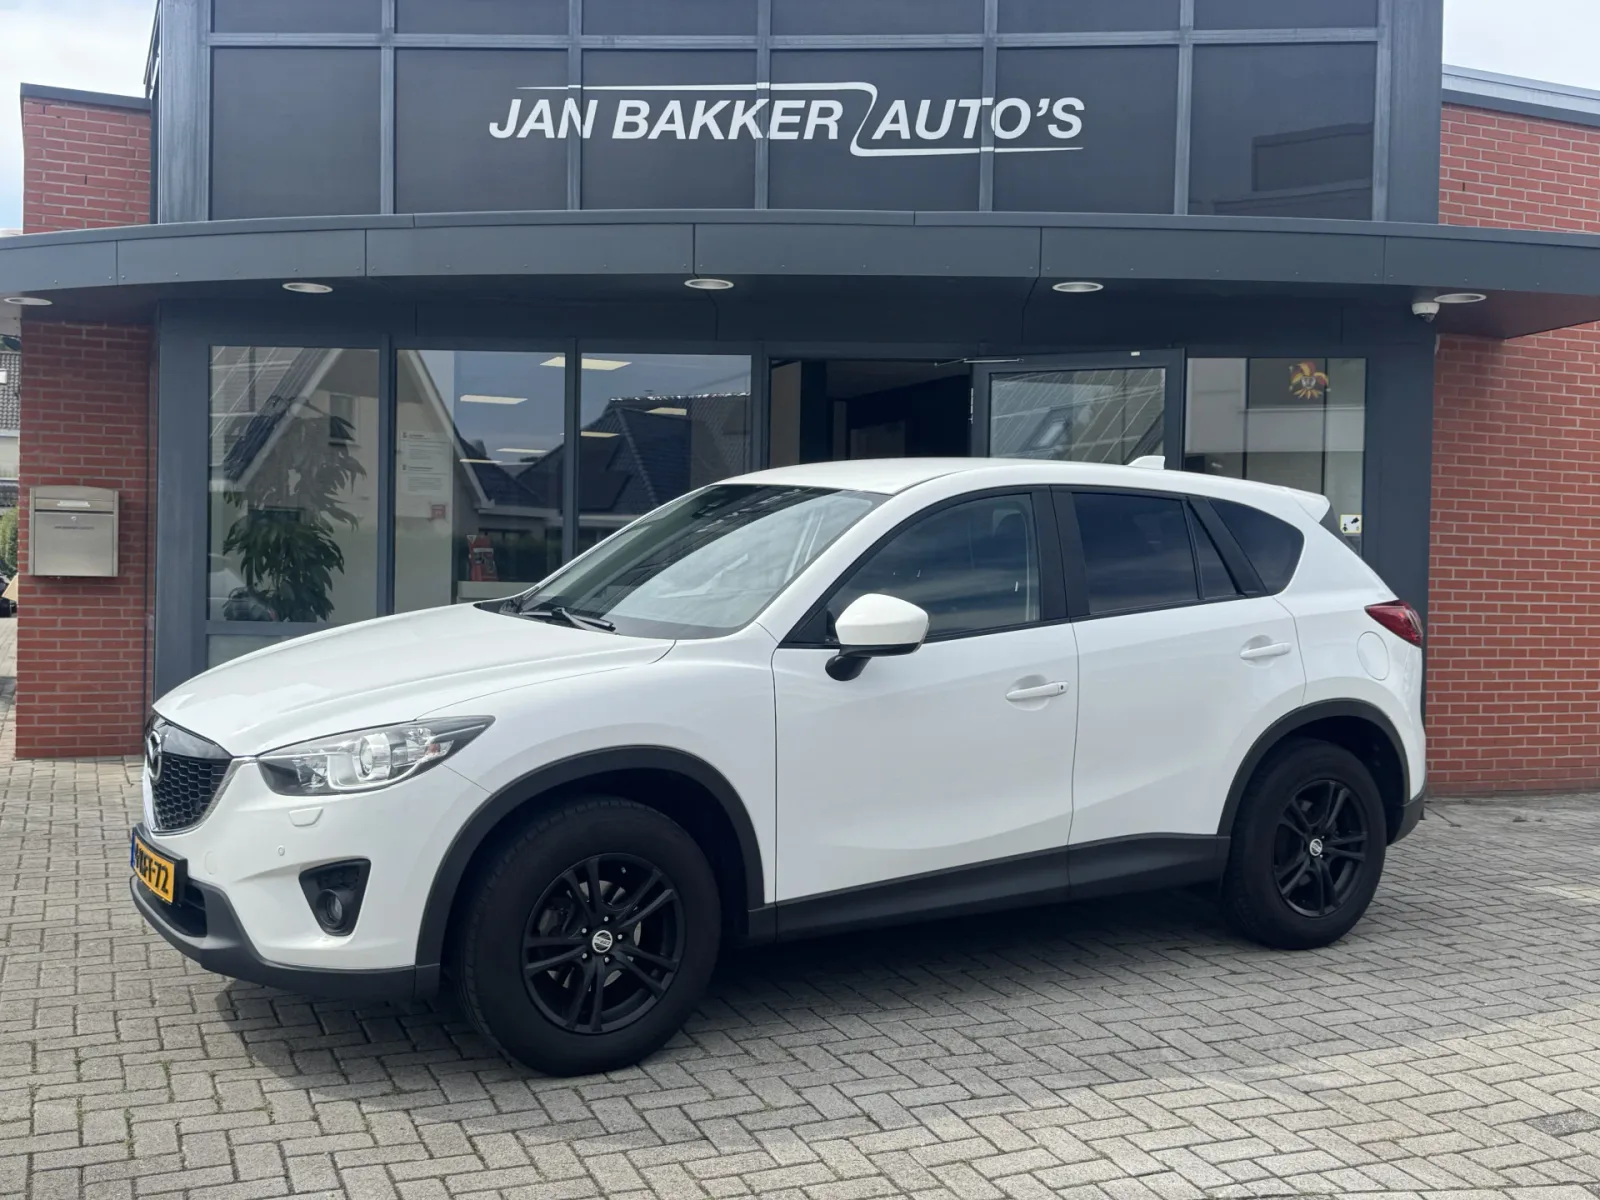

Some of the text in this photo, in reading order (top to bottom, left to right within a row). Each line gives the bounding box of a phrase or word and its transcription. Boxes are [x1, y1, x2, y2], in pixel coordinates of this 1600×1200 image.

[489, 97, 1085, 140] JAN BAKKER AUTO'S
